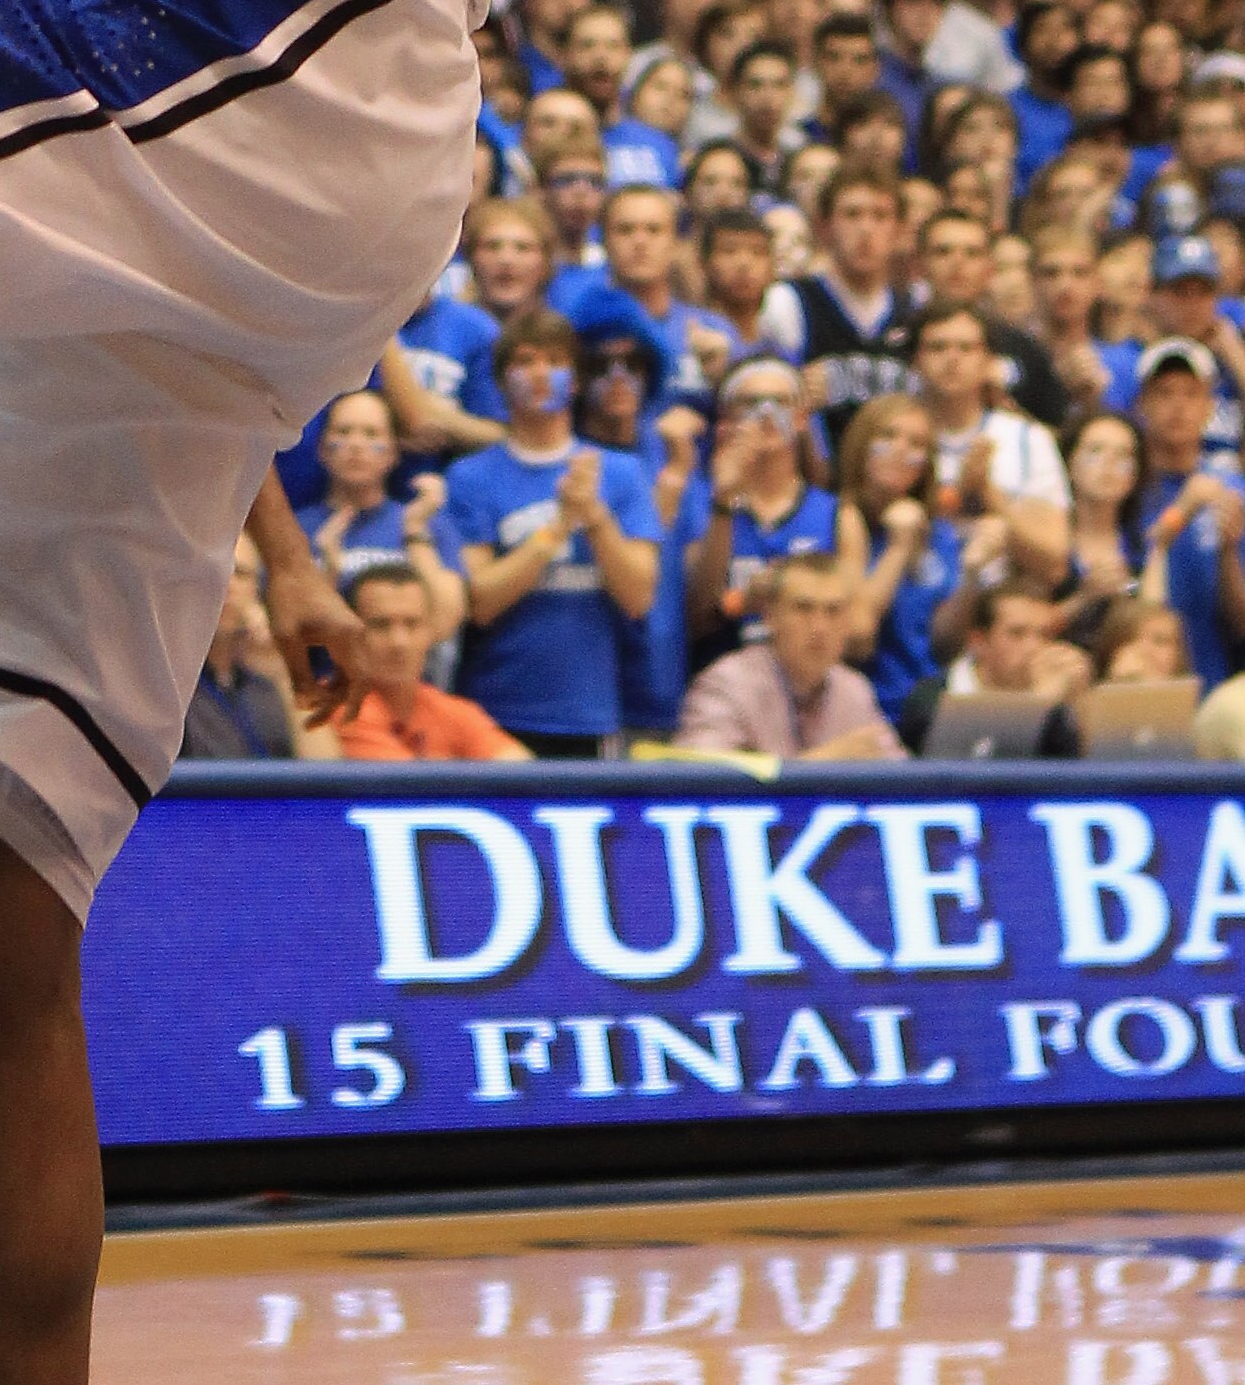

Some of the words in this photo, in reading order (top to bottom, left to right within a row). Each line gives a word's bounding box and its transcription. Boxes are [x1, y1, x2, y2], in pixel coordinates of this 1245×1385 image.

[349, 802, 1004, 983] DUKE
[1028, 800, 1245, 964] BA
[238, 1021, 406, 1111] 15
[468, 1006, 954, 1102] FINAL
